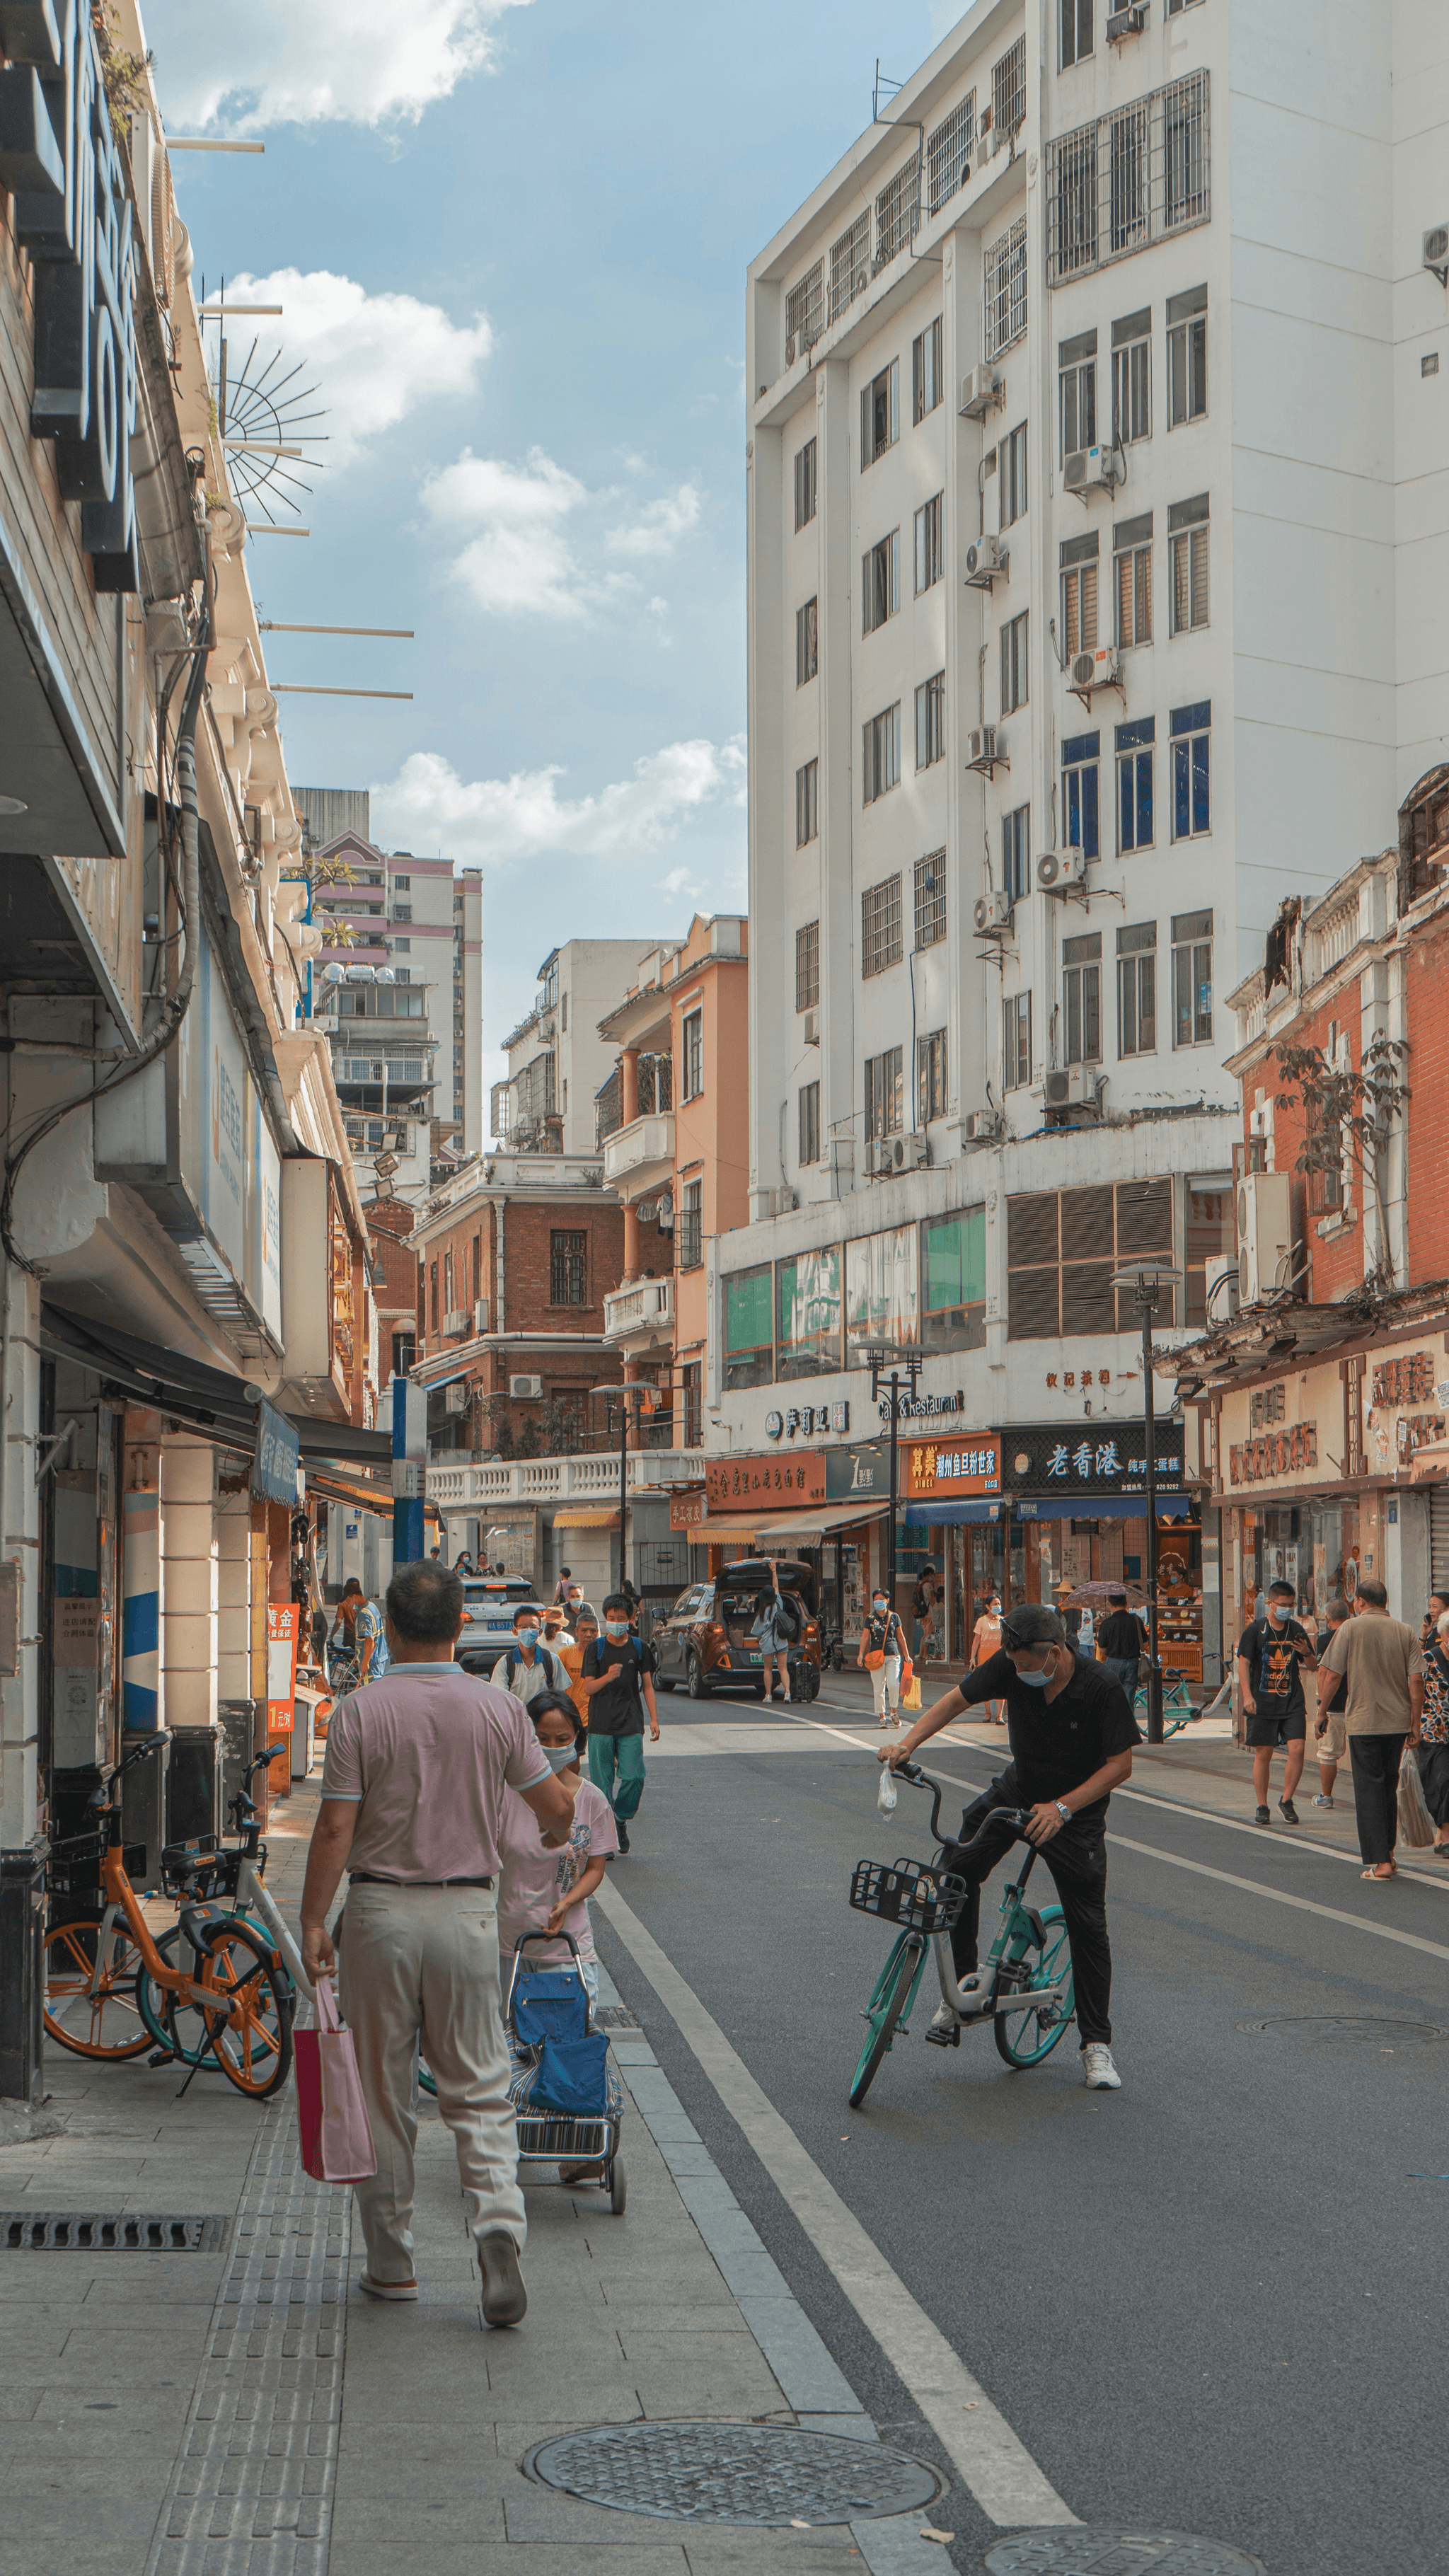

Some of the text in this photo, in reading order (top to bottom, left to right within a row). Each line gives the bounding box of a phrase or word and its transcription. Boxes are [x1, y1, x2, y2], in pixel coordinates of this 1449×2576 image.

[935, 1448, 995, 1479] 潮州鱼旦粉世家
[1046, 1440, 1124, 1479] 老香港
[1128, 1457, 1179, 1474] 纯手蛋糕
[267, 1629, 291, 1639] 量保证
[555, 1855, 567, 1885] SCHOOL
[560, 1858, 575, 1893] TRAINING
